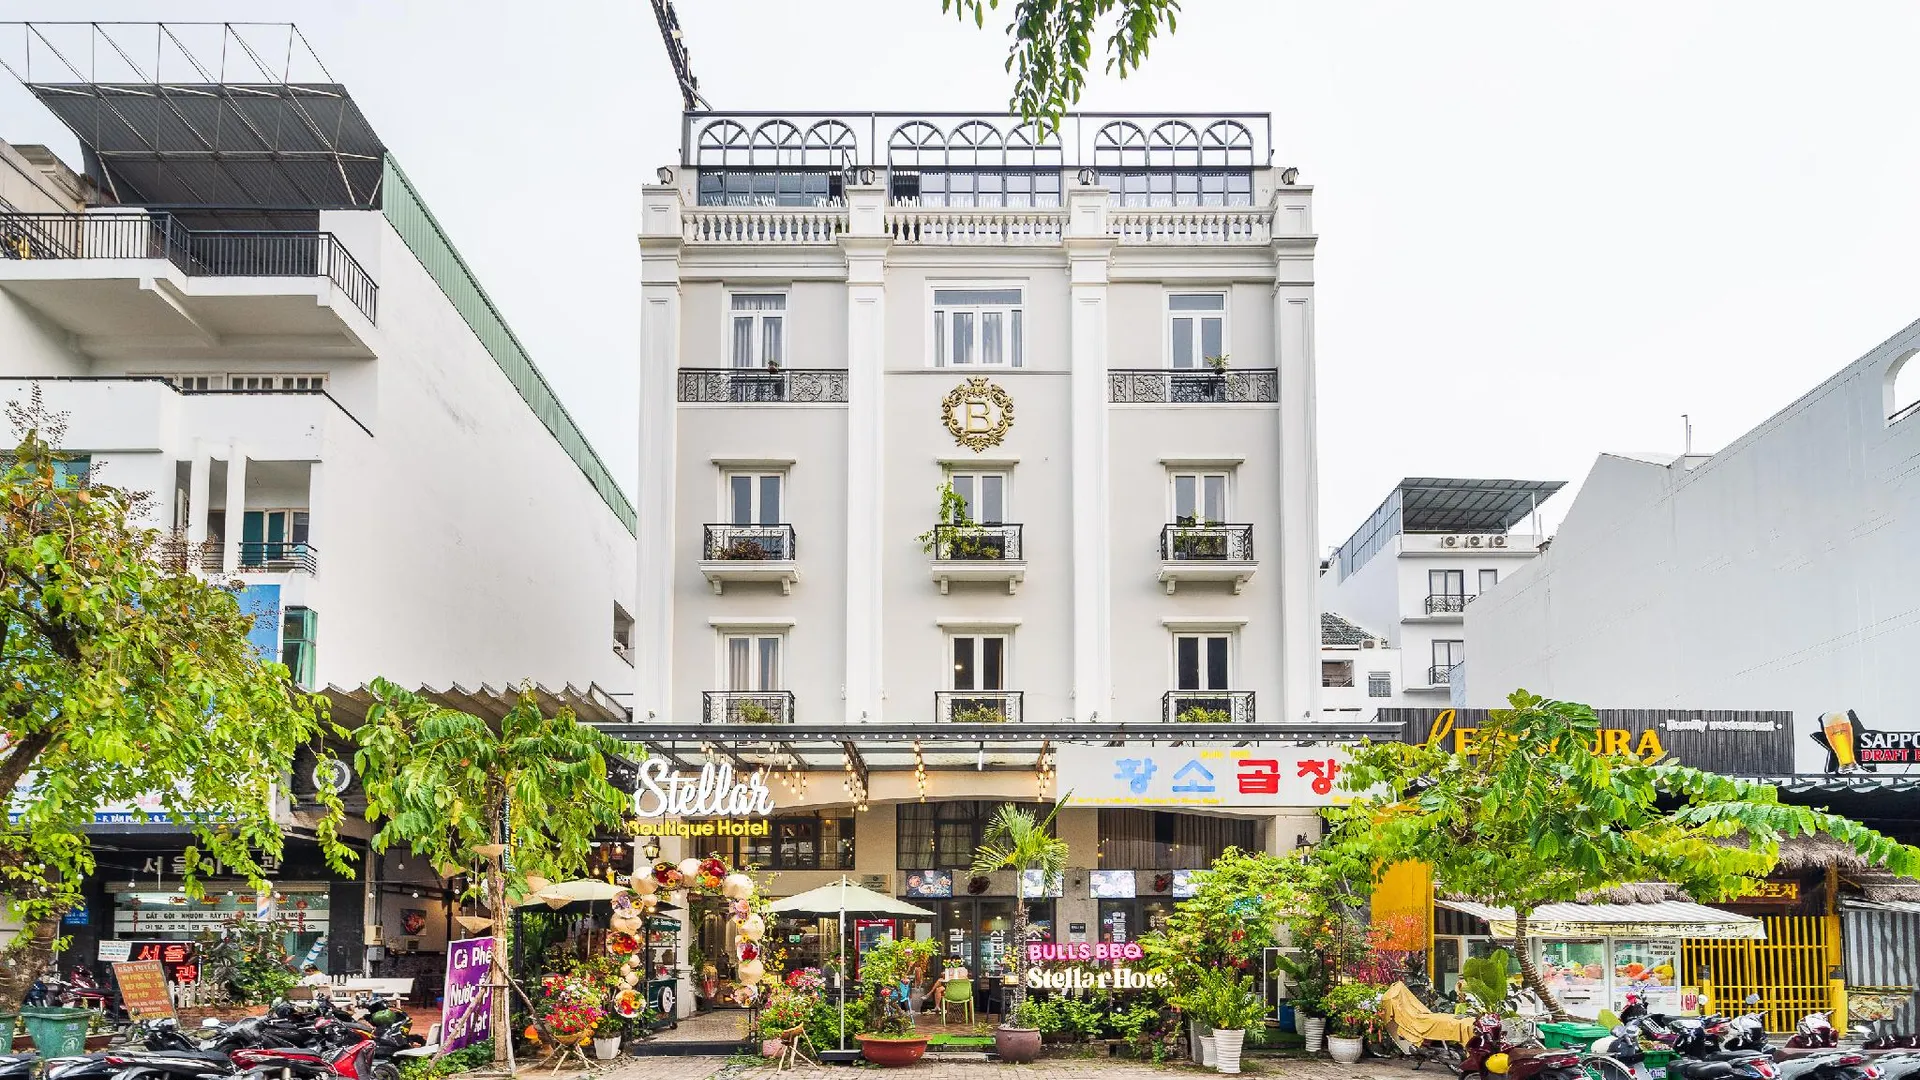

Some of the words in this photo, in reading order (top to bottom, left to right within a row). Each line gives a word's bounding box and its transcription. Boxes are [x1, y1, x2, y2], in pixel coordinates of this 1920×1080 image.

[965, 399, 993, 433] B
[1861, 749, 1909, 762] DRAFT
[632, 758, 774, 817] Stellar
[717, 820, 769, 836] Hotel
[454, 948, 469, 970] Cà
[471, 945, 493, 967] Phê
[1028, 943, 1091, 960] BULLS
[1095, 941, 1144, 960] BBQ
[1027, 966, 1112, 989] Stellar
